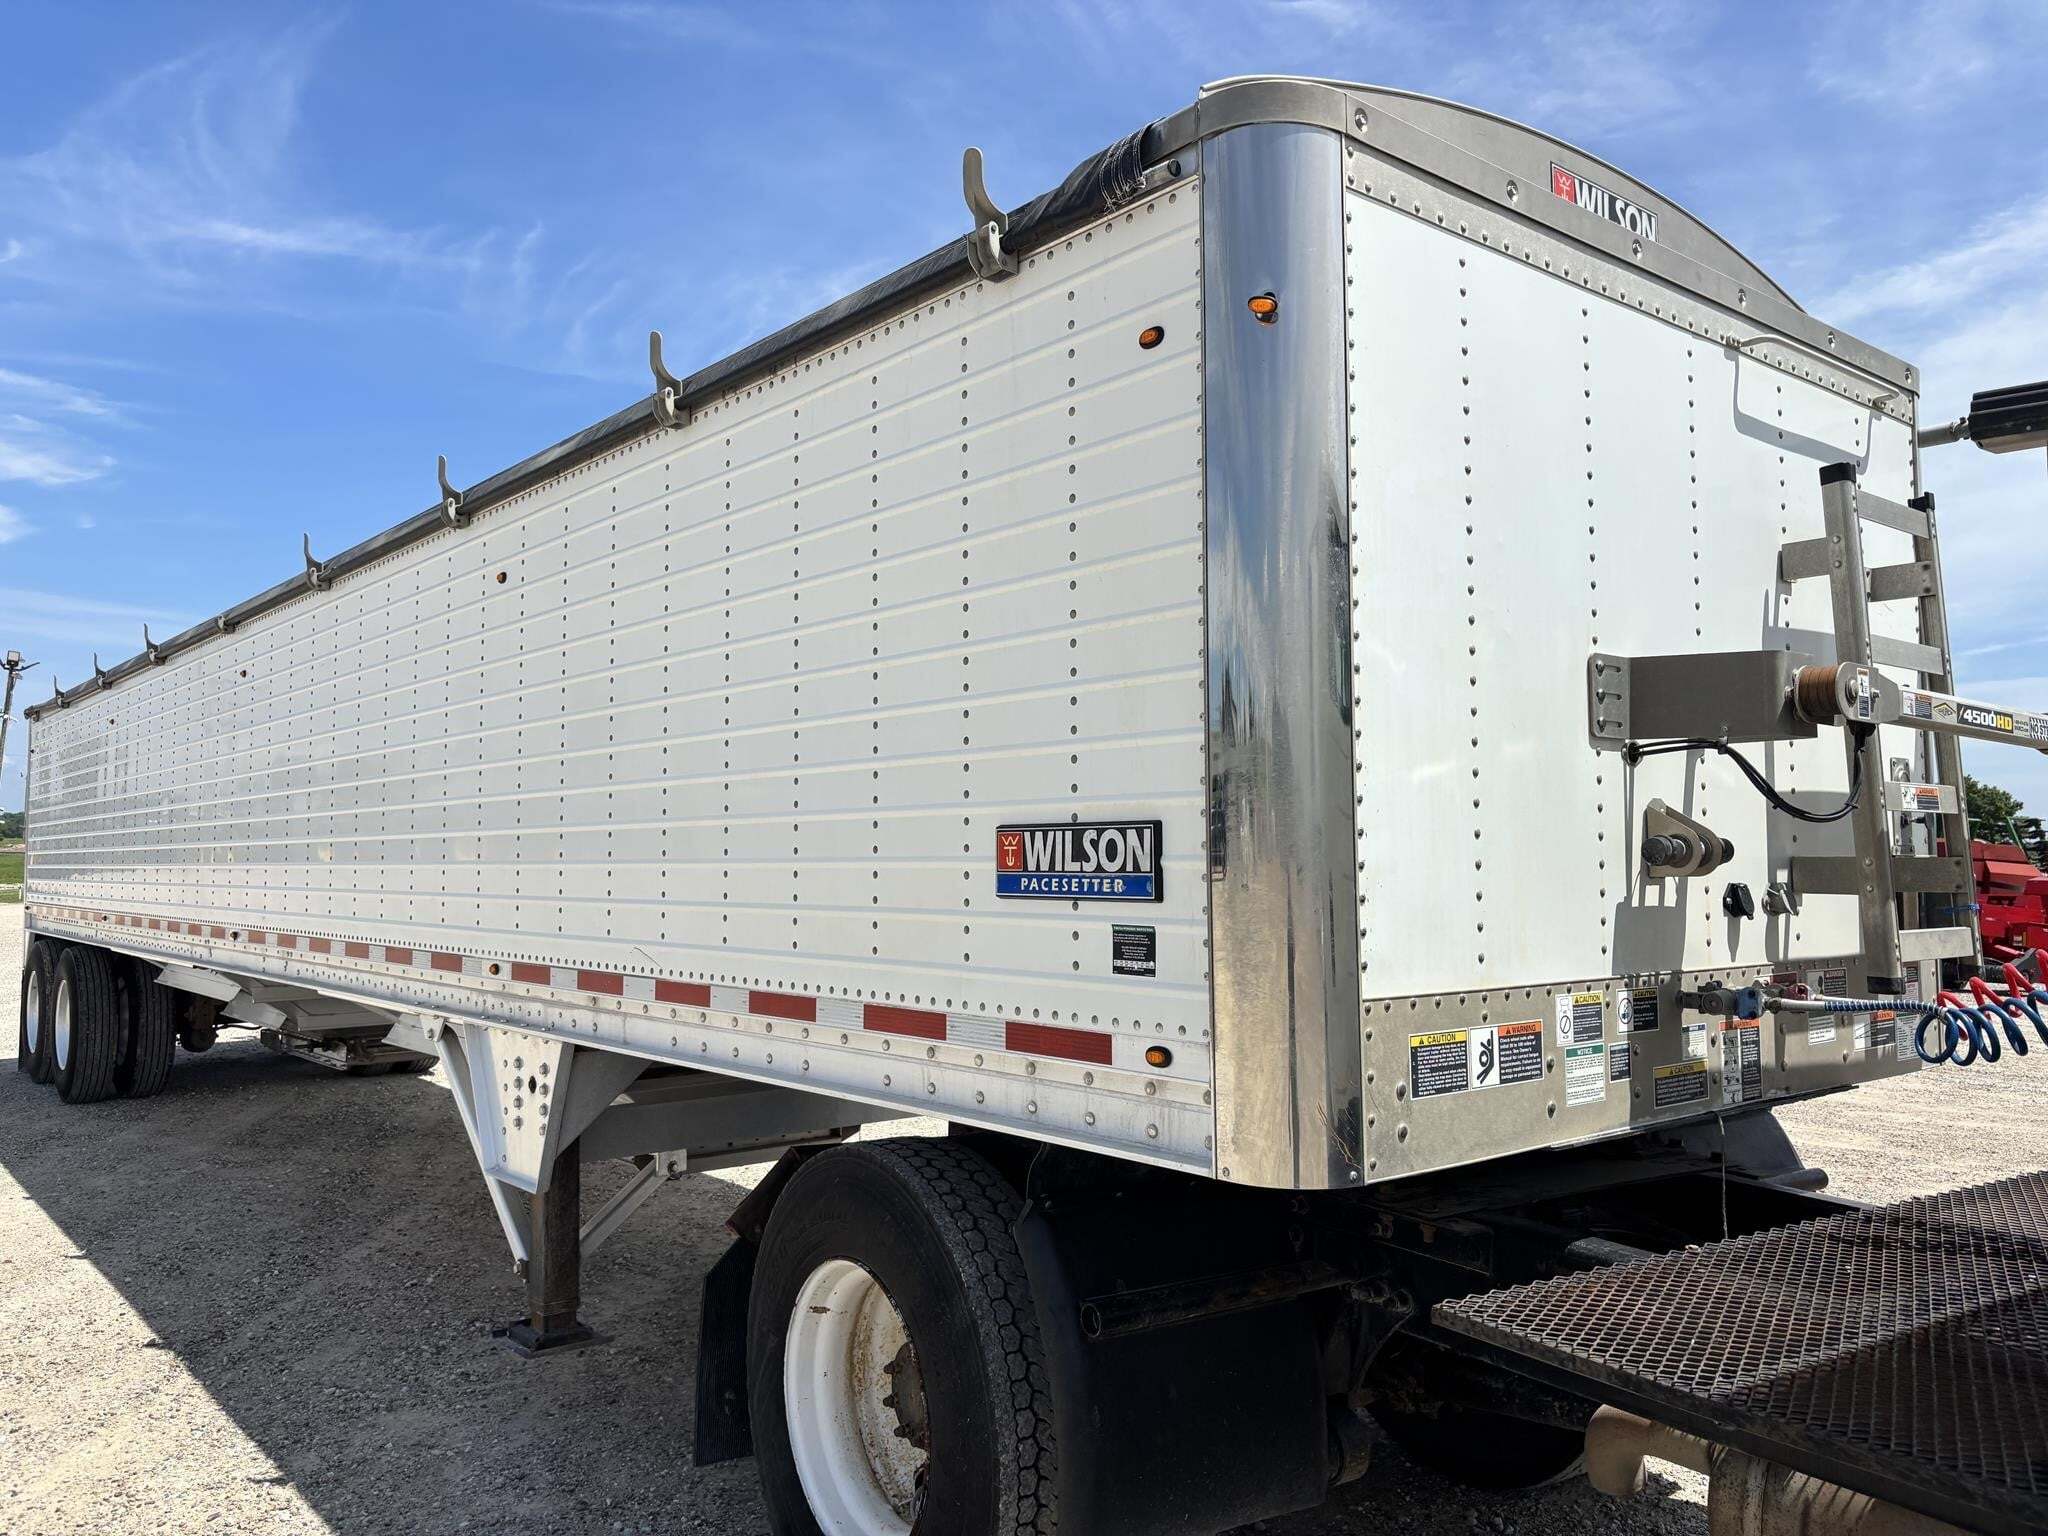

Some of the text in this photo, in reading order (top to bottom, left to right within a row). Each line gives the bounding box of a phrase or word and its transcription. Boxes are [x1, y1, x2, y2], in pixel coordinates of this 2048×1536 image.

[1575, 178, 1657, 241] WILSON
[1963, 709, 2013, 731] 4500HD
[1023, 828, 1151, 873] WILSON
[1020, 877, 1124, 893] PACESETTER
[1579, 994, 1600, 1004] CAUTION
[1512, 1024, 1537, 1035] WARNING
[1427, 1033, 1456, 1044] CAUTION
[1576, 1047, 1593, 1056] NOTICE
